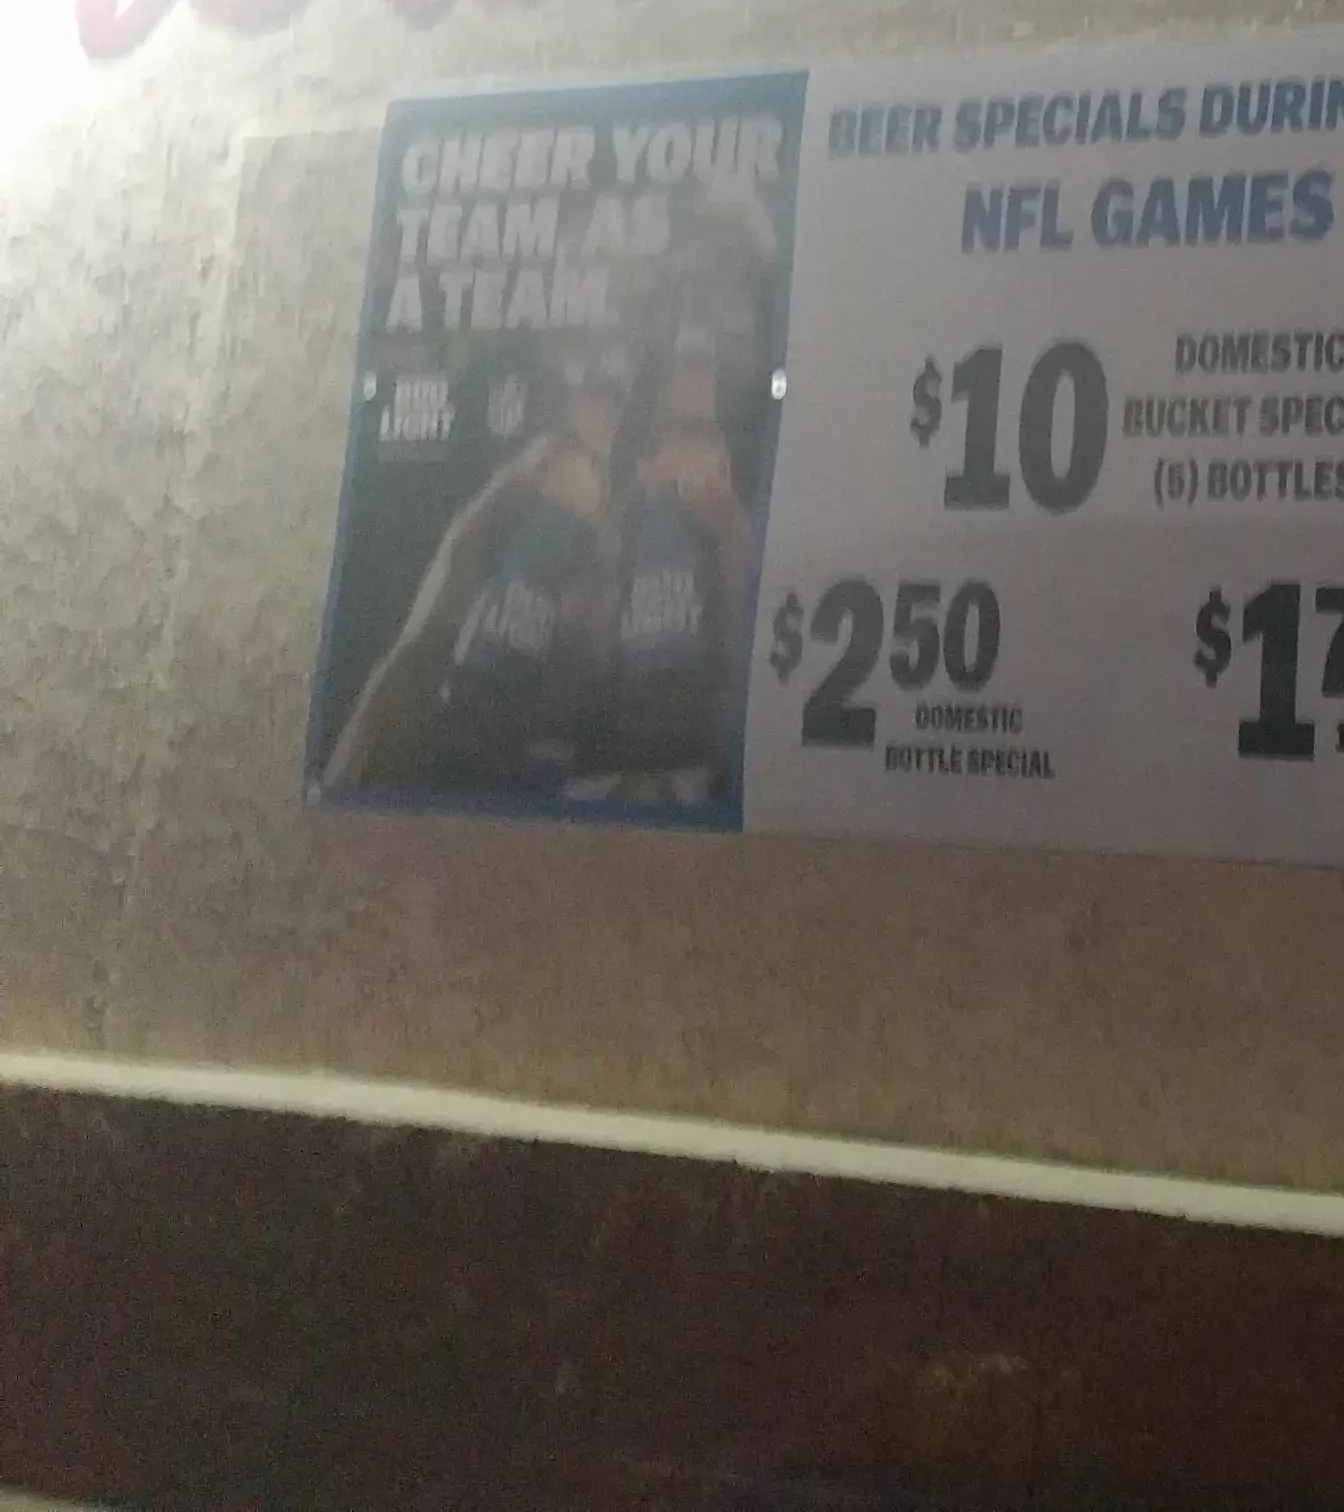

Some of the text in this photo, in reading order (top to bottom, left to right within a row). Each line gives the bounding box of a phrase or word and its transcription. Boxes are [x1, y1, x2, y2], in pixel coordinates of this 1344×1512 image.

[400, 112, 784, 194] CHEER YOUR
[826, 99, 945, 160] BEER
[951, 85, 1191, 152] SPECIALS
[395, 191, 672, 264] TEAM AS
[959, 163, 1336, 256] NFL GAMES
[385, 272, 423, 334] A
[908, 334, 1110, 518] $10
[1120, 394, 1251, 440] BUCKET
[1152, 456, 1200, 508] (5)
[914, 700, 1025, 736] DOMESTIC
[884, 739, 1058, 781] BOTTLE SPECIAL
